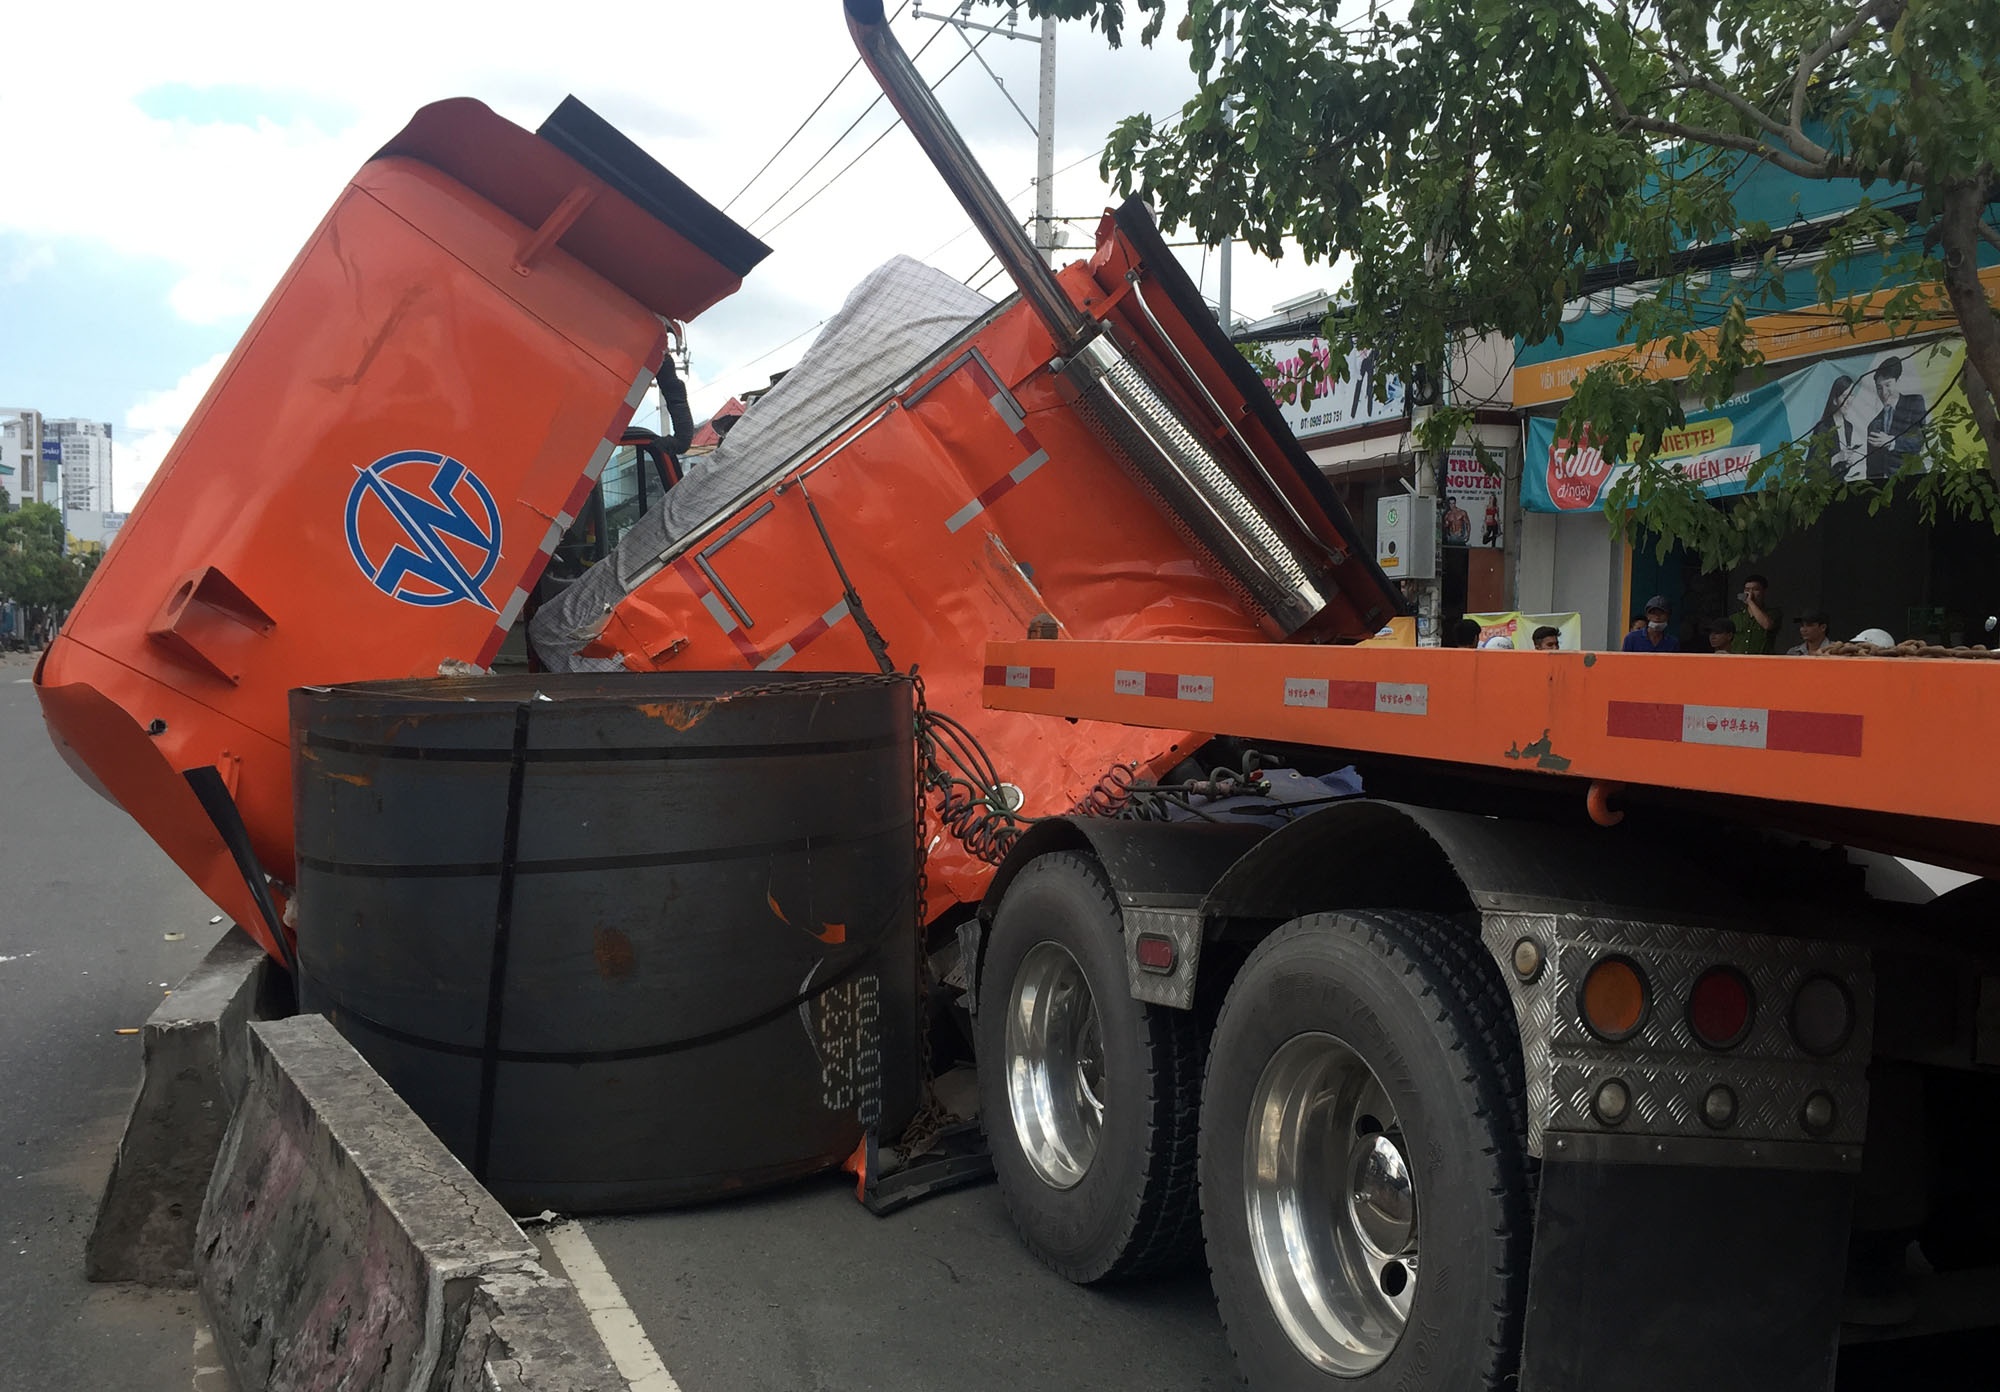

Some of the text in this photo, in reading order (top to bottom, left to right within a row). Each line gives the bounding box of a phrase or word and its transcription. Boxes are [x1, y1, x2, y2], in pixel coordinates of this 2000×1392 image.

[1450, 459, 1486, 473] TRUN
[1554, 445, 1605, 479] 5.000
[1725, 450, 1754, 473] PHÍ
[1557, 481, 1591, 501] đ/ngày
[1720, 717, 1760, 733] 中集车辆
